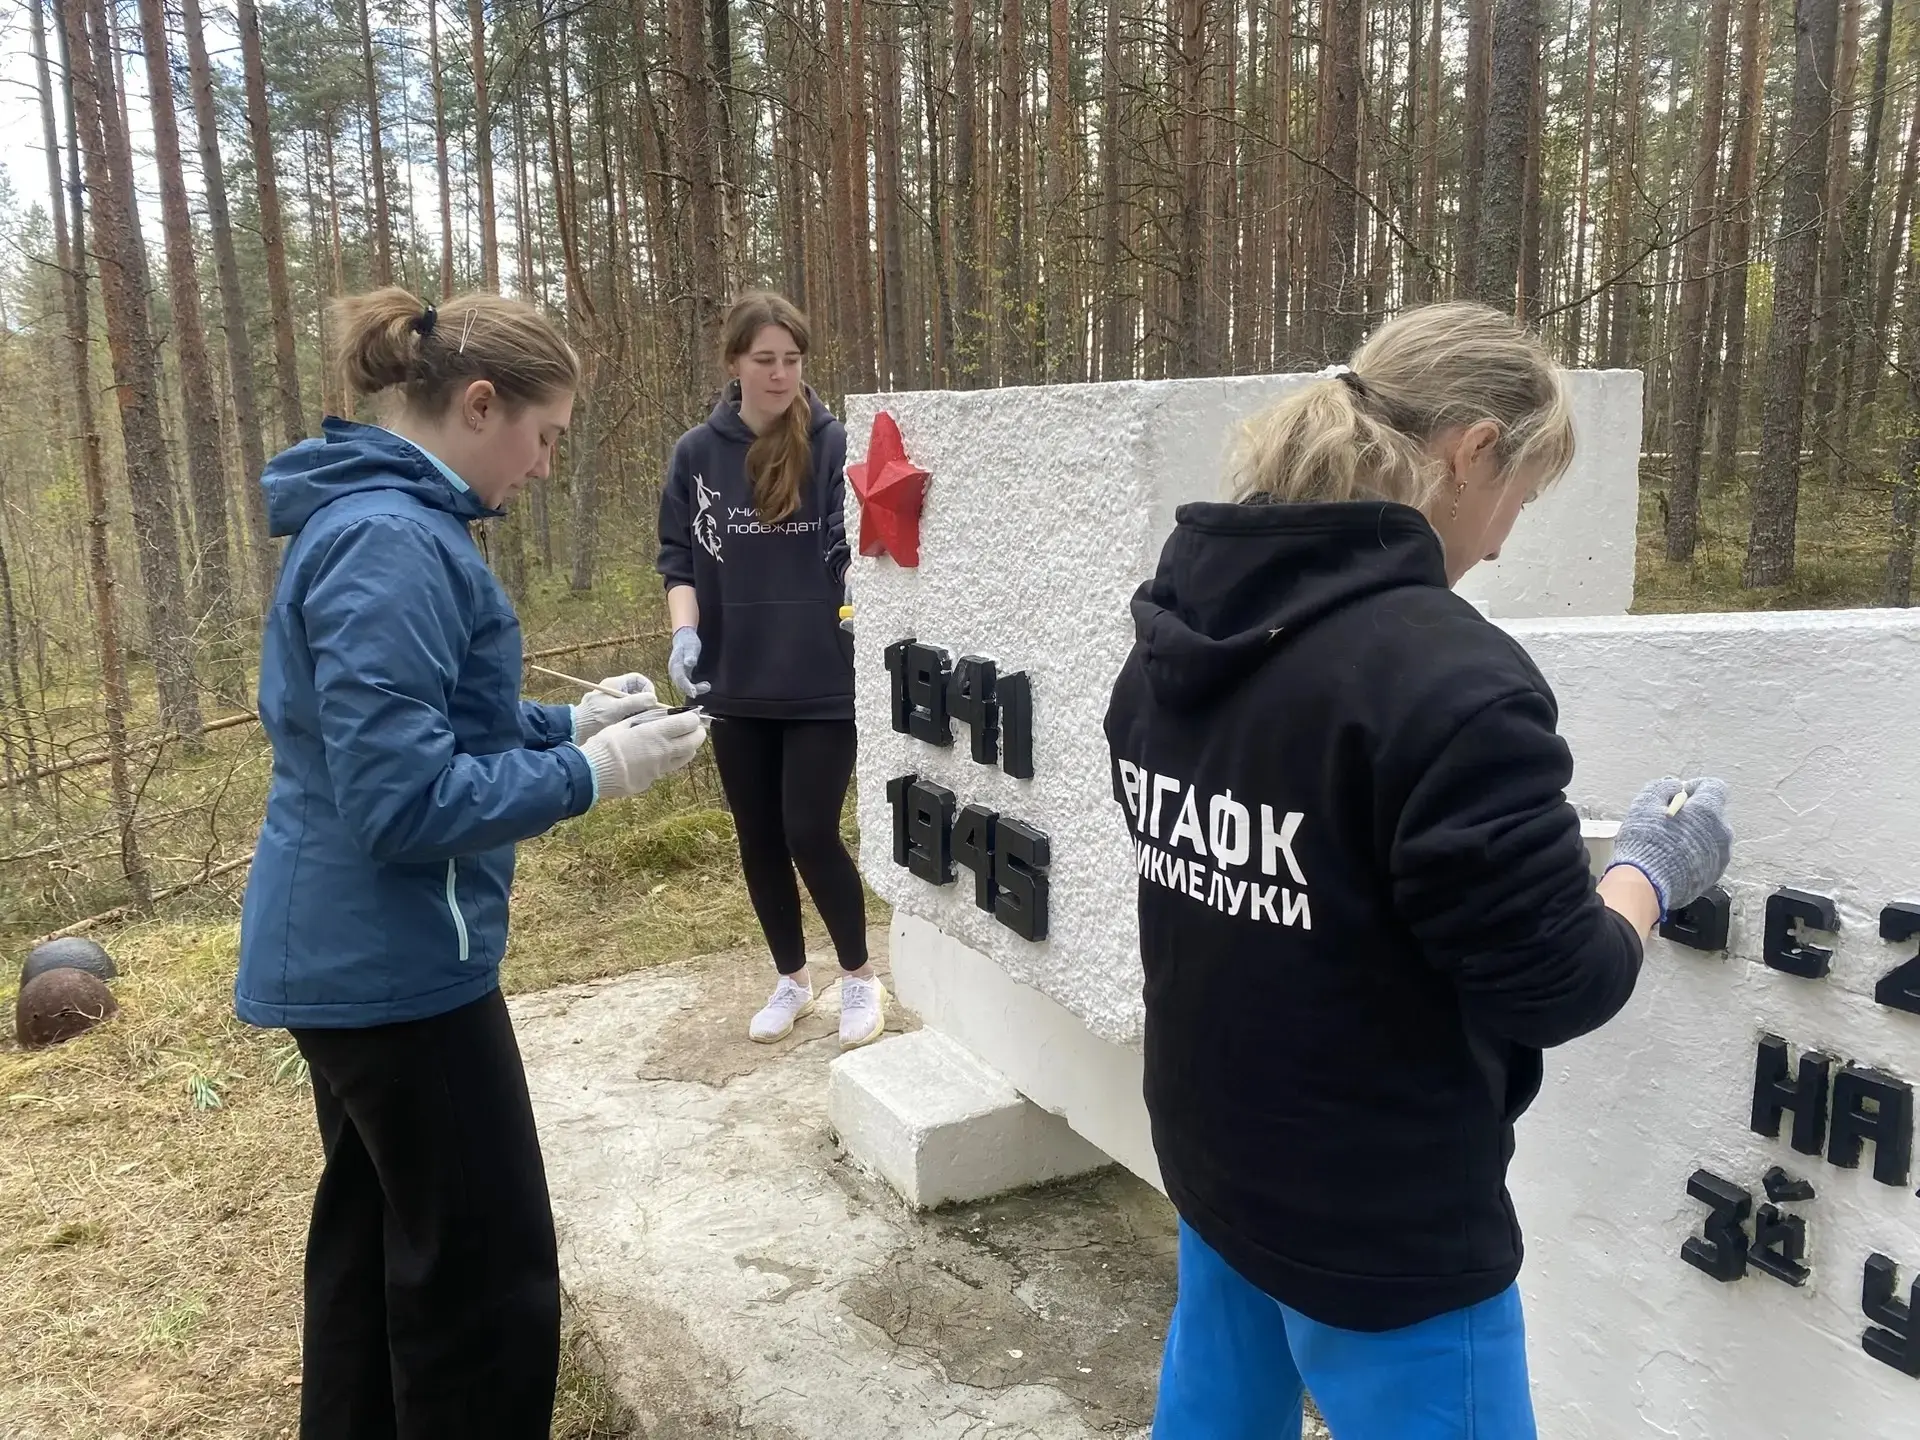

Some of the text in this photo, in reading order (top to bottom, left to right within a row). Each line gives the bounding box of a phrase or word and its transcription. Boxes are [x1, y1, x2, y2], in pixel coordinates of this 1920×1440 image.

[884, 638, 1035, 779] 1941
[886, 774, 1051, 942] 1945
[1750, 1034, 1920, 1198] НА
